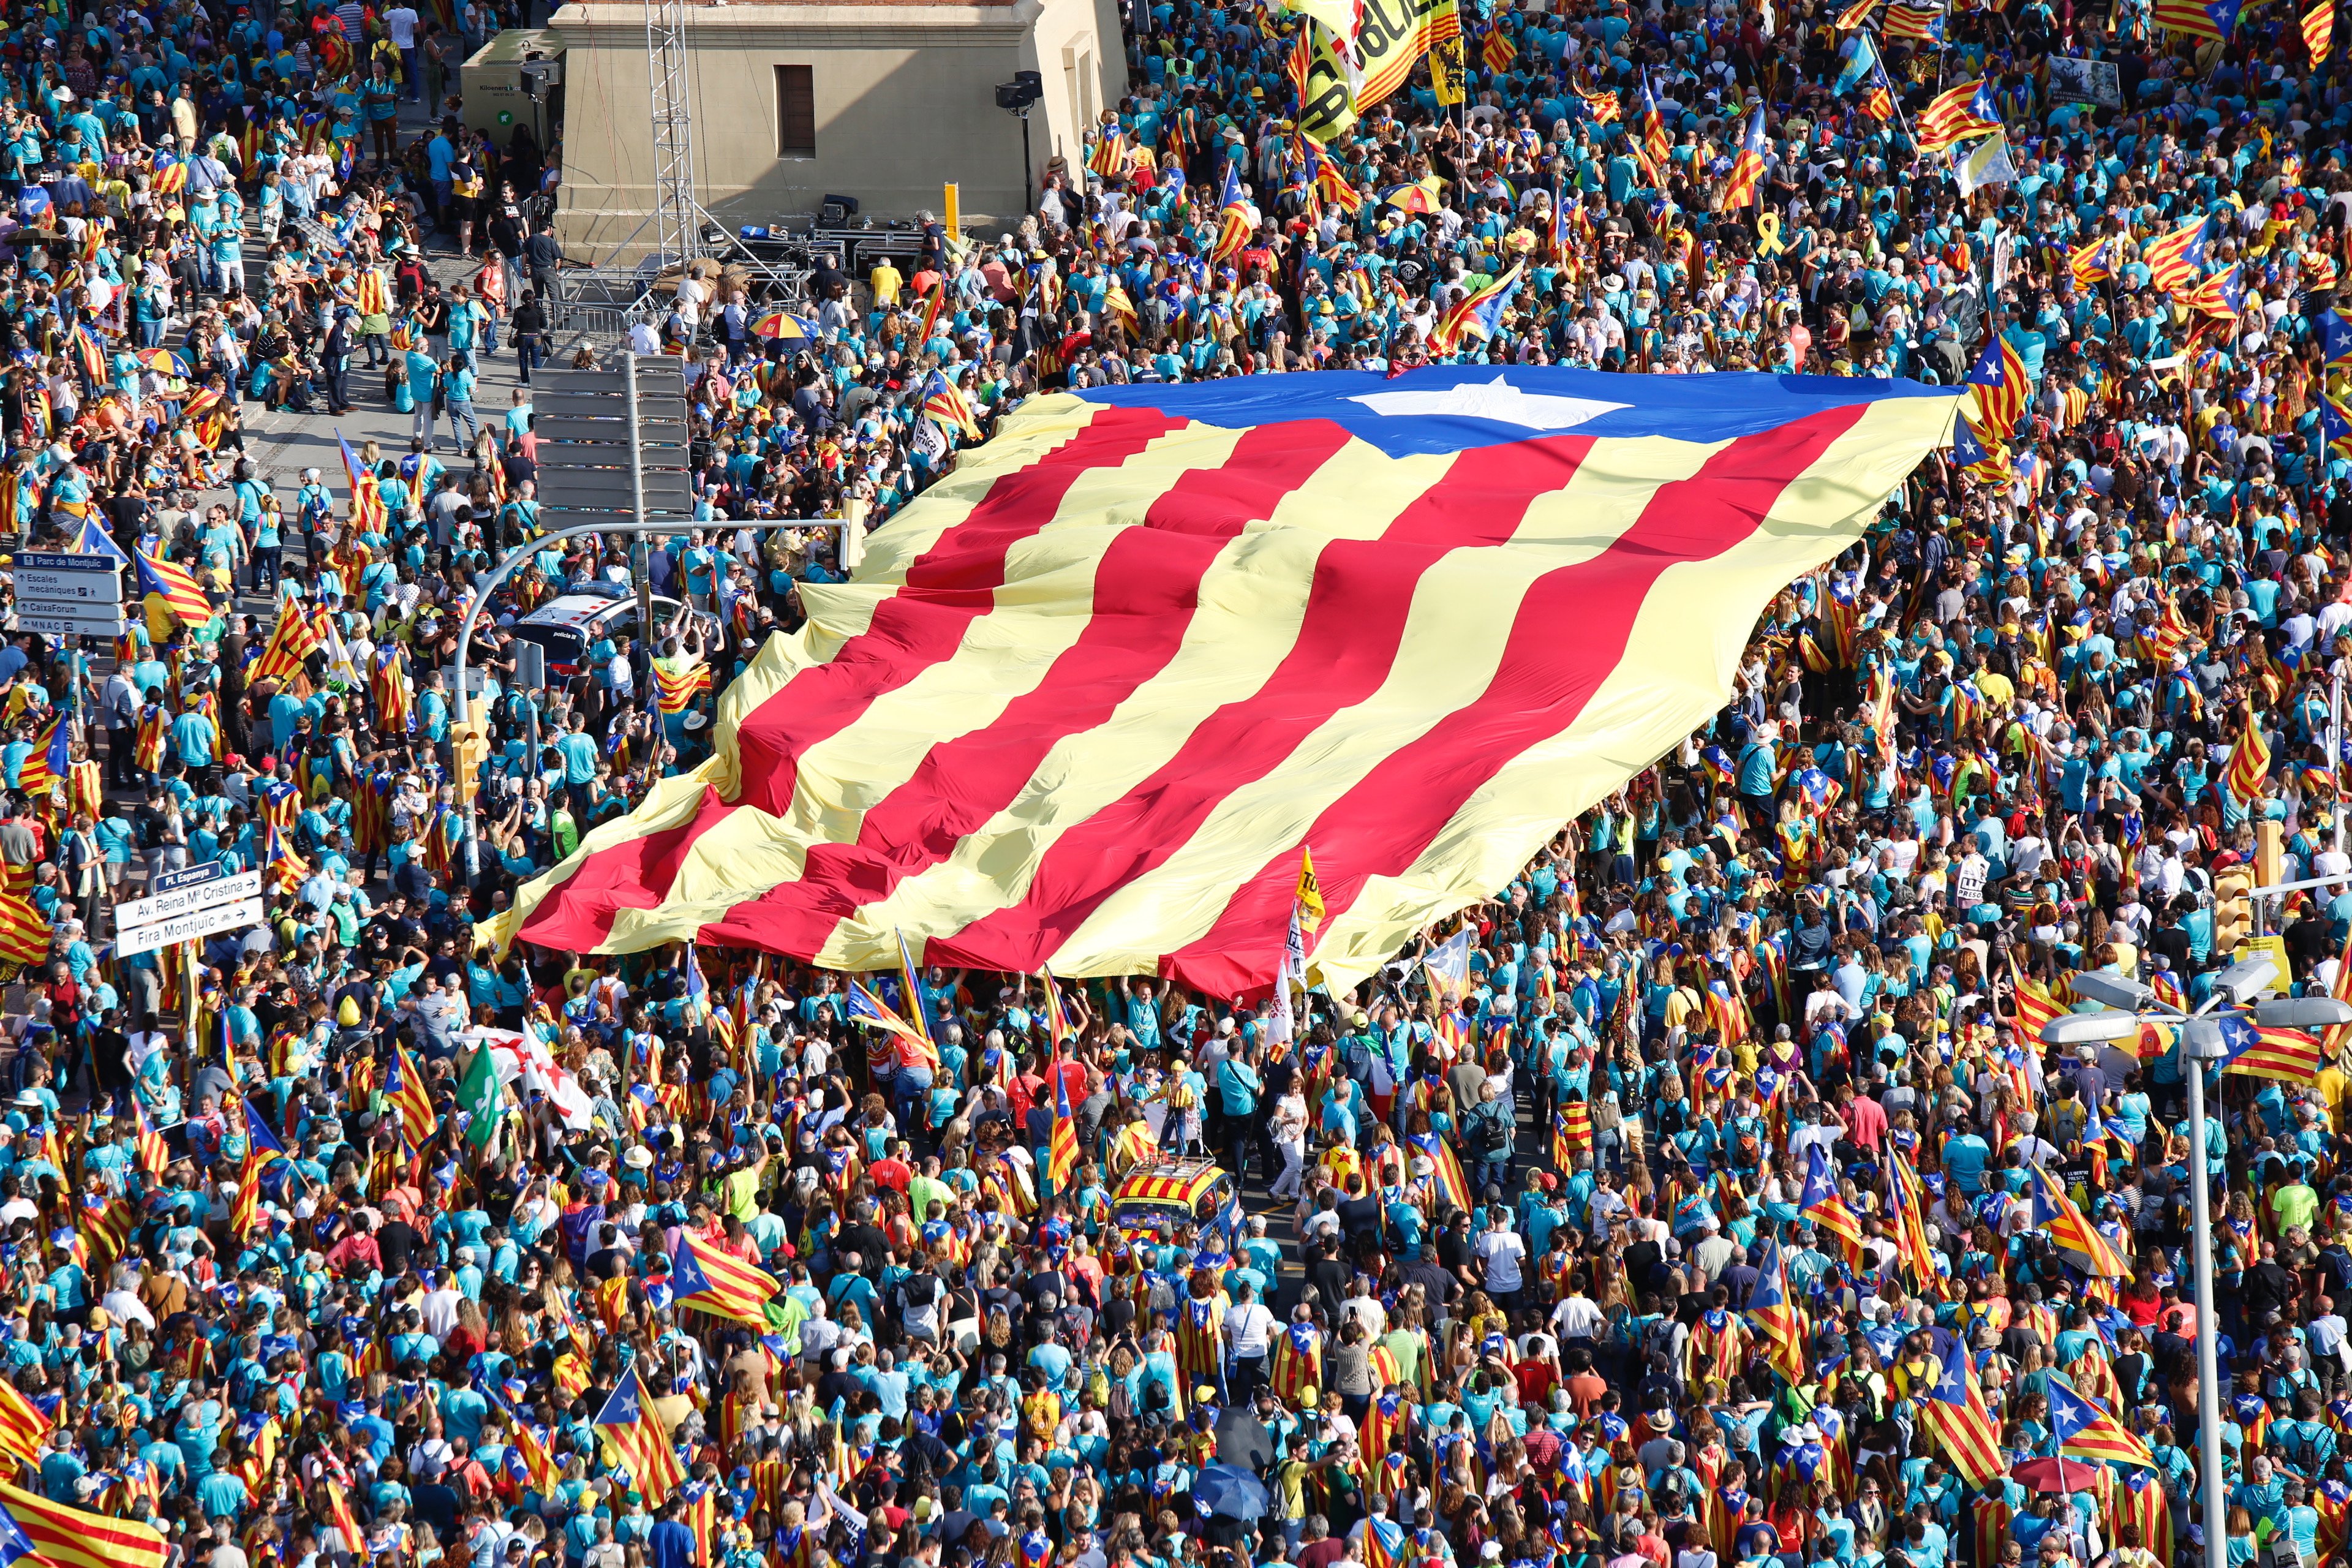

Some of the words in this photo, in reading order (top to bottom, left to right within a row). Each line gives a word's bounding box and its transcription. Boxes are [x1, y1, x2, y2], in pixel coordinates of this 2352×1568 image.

[68, 559, 102, 568] Montjuïc
[28, 575, 58, 583] Escales
[31, 603, 77, 613] CaixaForum
[31, 621, 60, 630] MNAC
[165, 876, 176, 886] Pl.
[177, 868, 209, 882] Espanya
[137, 905, 153, 918] Av.
[156, 897, 184, 913] Reina
[203, 882, 243, 900] Cristina
[138, 932, 160, 945] Fira
[165, 914, 214, 938] Montjuïc
